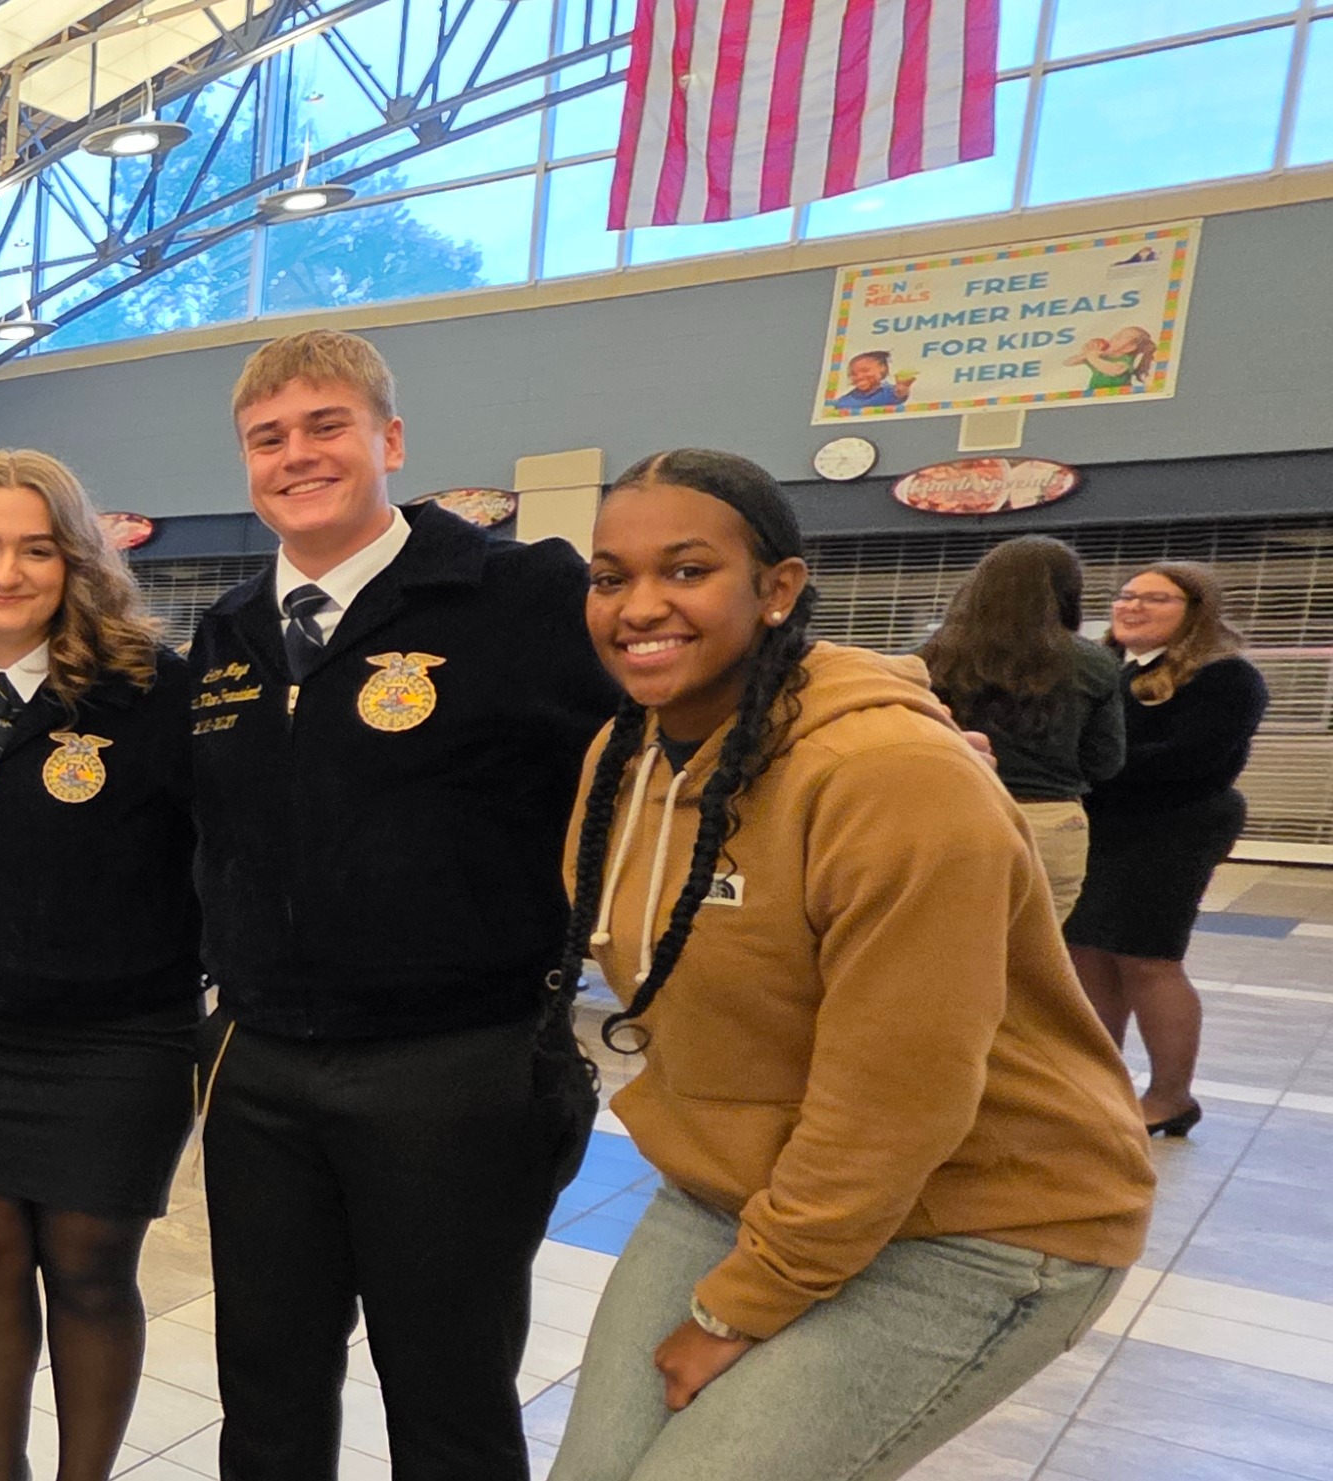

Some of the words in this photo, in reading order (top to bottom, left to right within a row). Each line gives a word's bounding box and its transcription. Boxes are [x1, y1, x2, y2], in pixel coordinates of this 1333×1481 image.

[964, 271, 1049, 298] FREE
[864, 290, 932, 308] MEALS
[871, 306, 1010, 335] SUMMER
[1019, 289, 1141, 320] MEALS
[921, 335, 987, 359] FOR
[997, 326, 1077, 351] KIDS
[952, 360, 1043, 384] HERE
